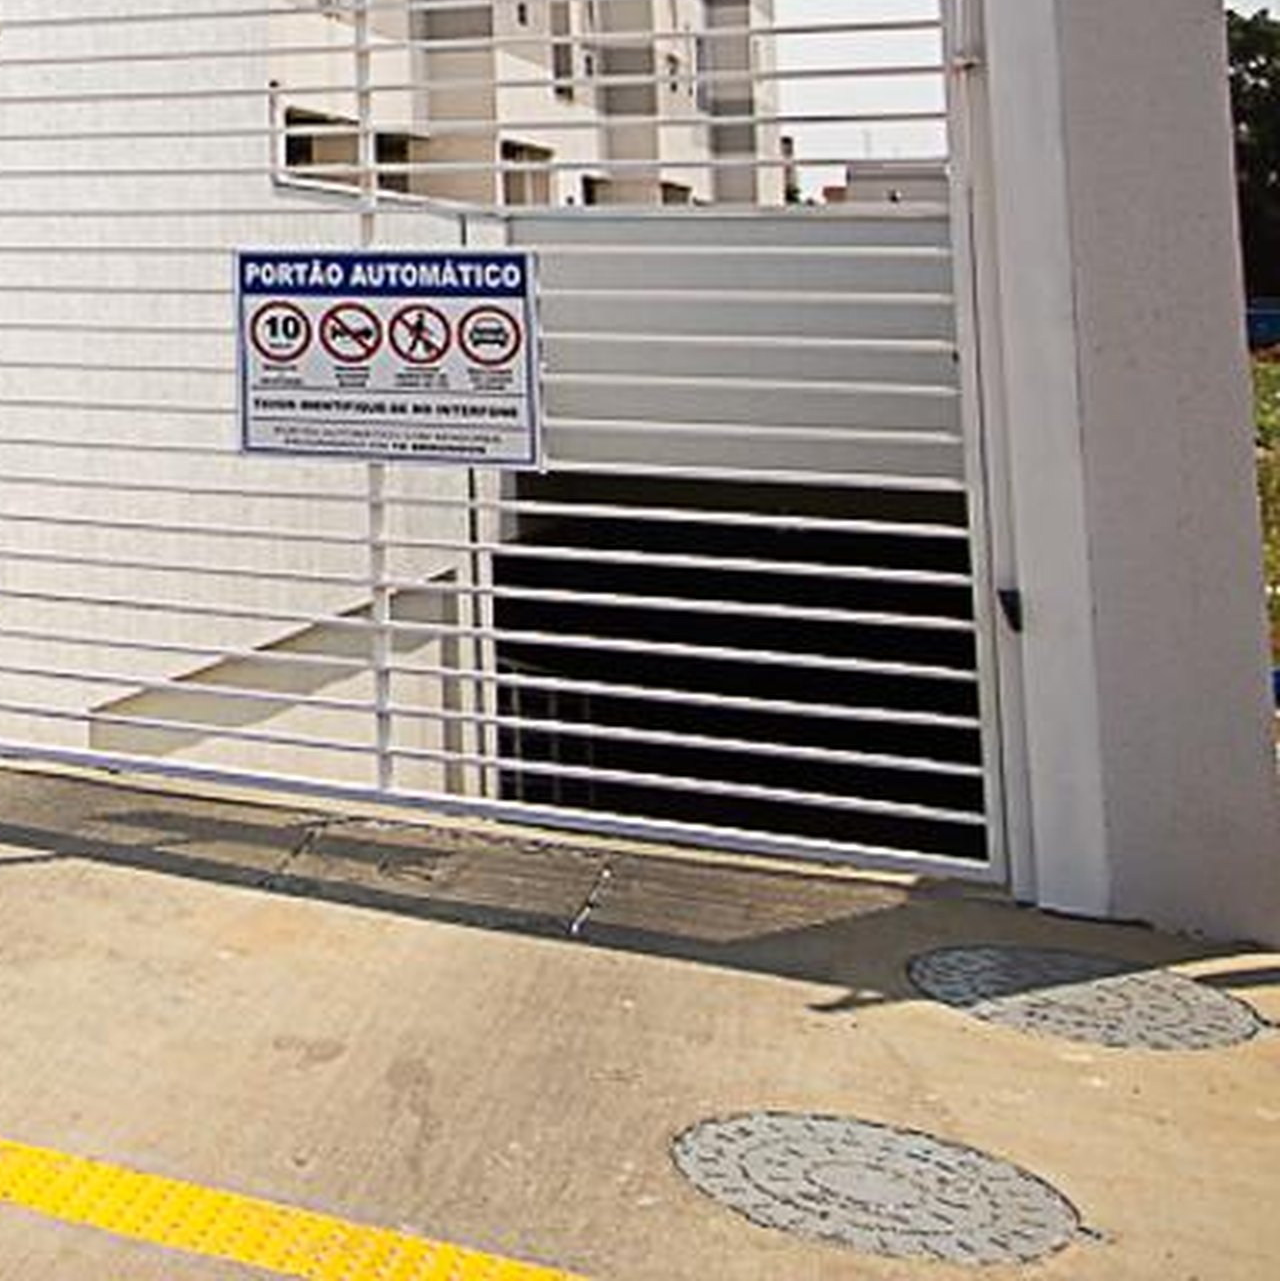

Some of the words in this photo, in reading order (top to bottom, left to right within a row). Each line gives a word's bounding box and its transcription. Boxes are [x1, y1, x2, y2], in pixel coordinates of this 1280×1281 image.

[245, 259, 344, 288] PORTÃO
[349, 259, 521, 288] AUTOMÁTICO
[264, 315, 300, 339] 10
